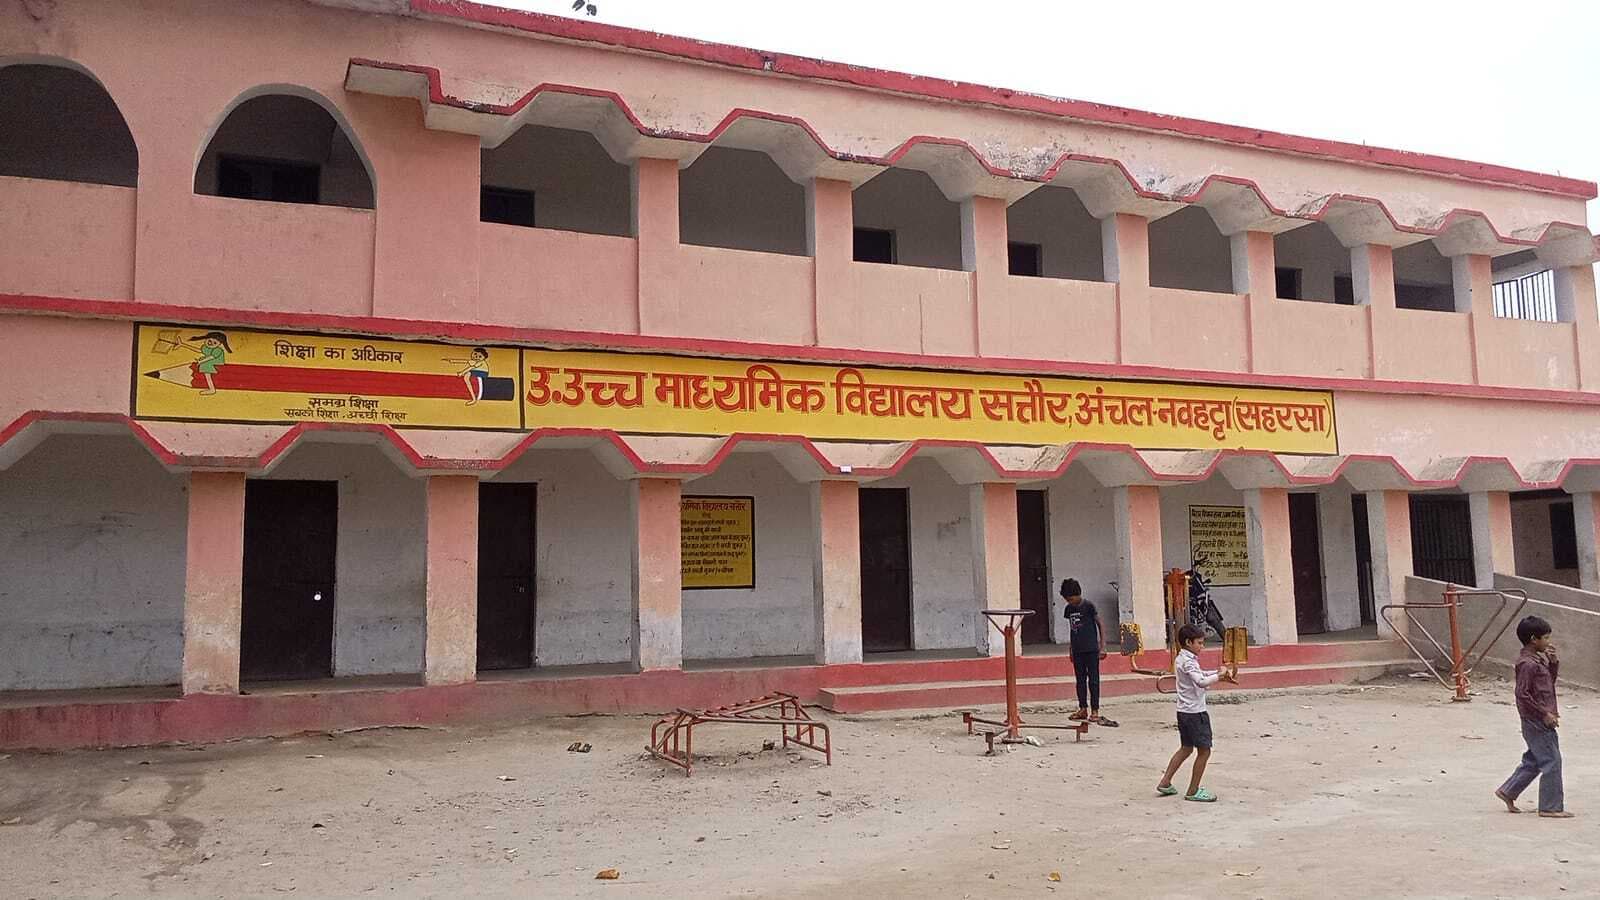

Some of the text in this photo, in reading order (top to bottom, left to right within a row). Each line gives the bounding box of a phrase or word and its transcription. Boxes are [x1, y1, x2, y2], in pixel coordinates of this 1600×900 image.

[274, 340, 404, 364] शिक्षा का अधिकार
[308, 395, 380, 409] समग्र शिक्षा
[651, 364, 827, 414] माध्यमिक
[830, 368, 974, 419] विद्यालय
